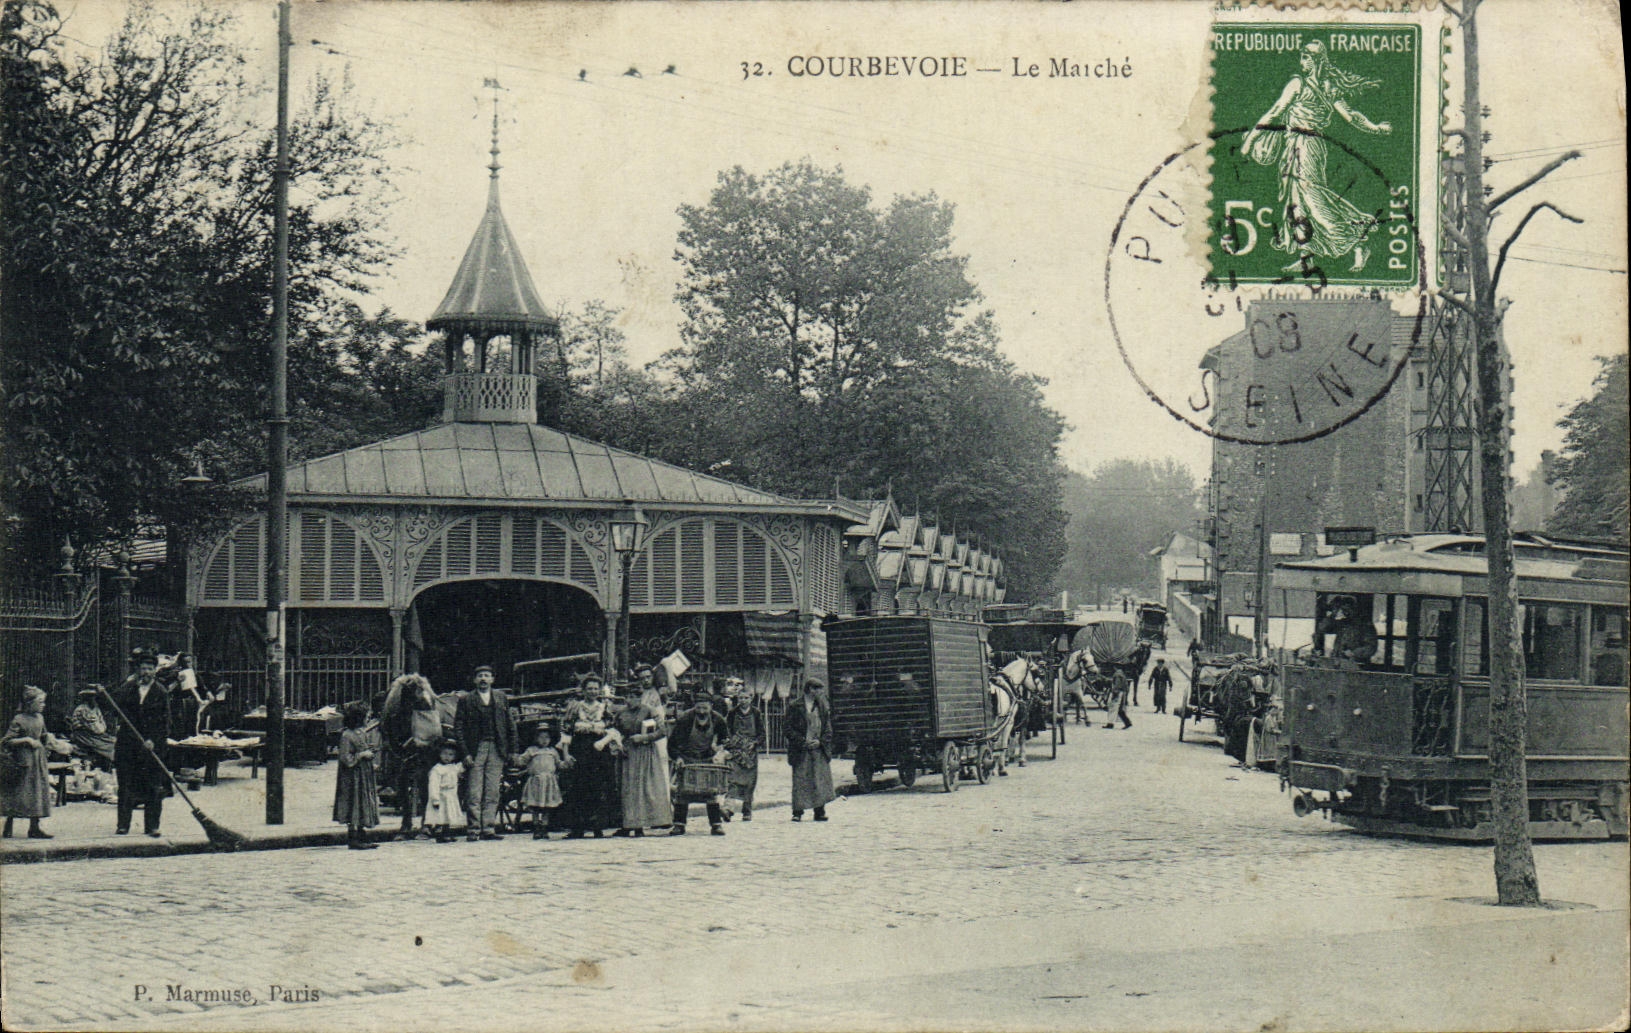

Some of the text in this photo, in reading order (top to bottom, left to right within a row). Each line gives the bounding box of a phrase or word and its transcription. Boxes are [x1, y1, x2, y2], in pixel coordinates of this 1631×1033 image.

[1330, 34, 1412, 53] FRANÇAISE
[1389, 185, 1409, 269] POSTES
[1188, 333, 1390, 431] SEINE
